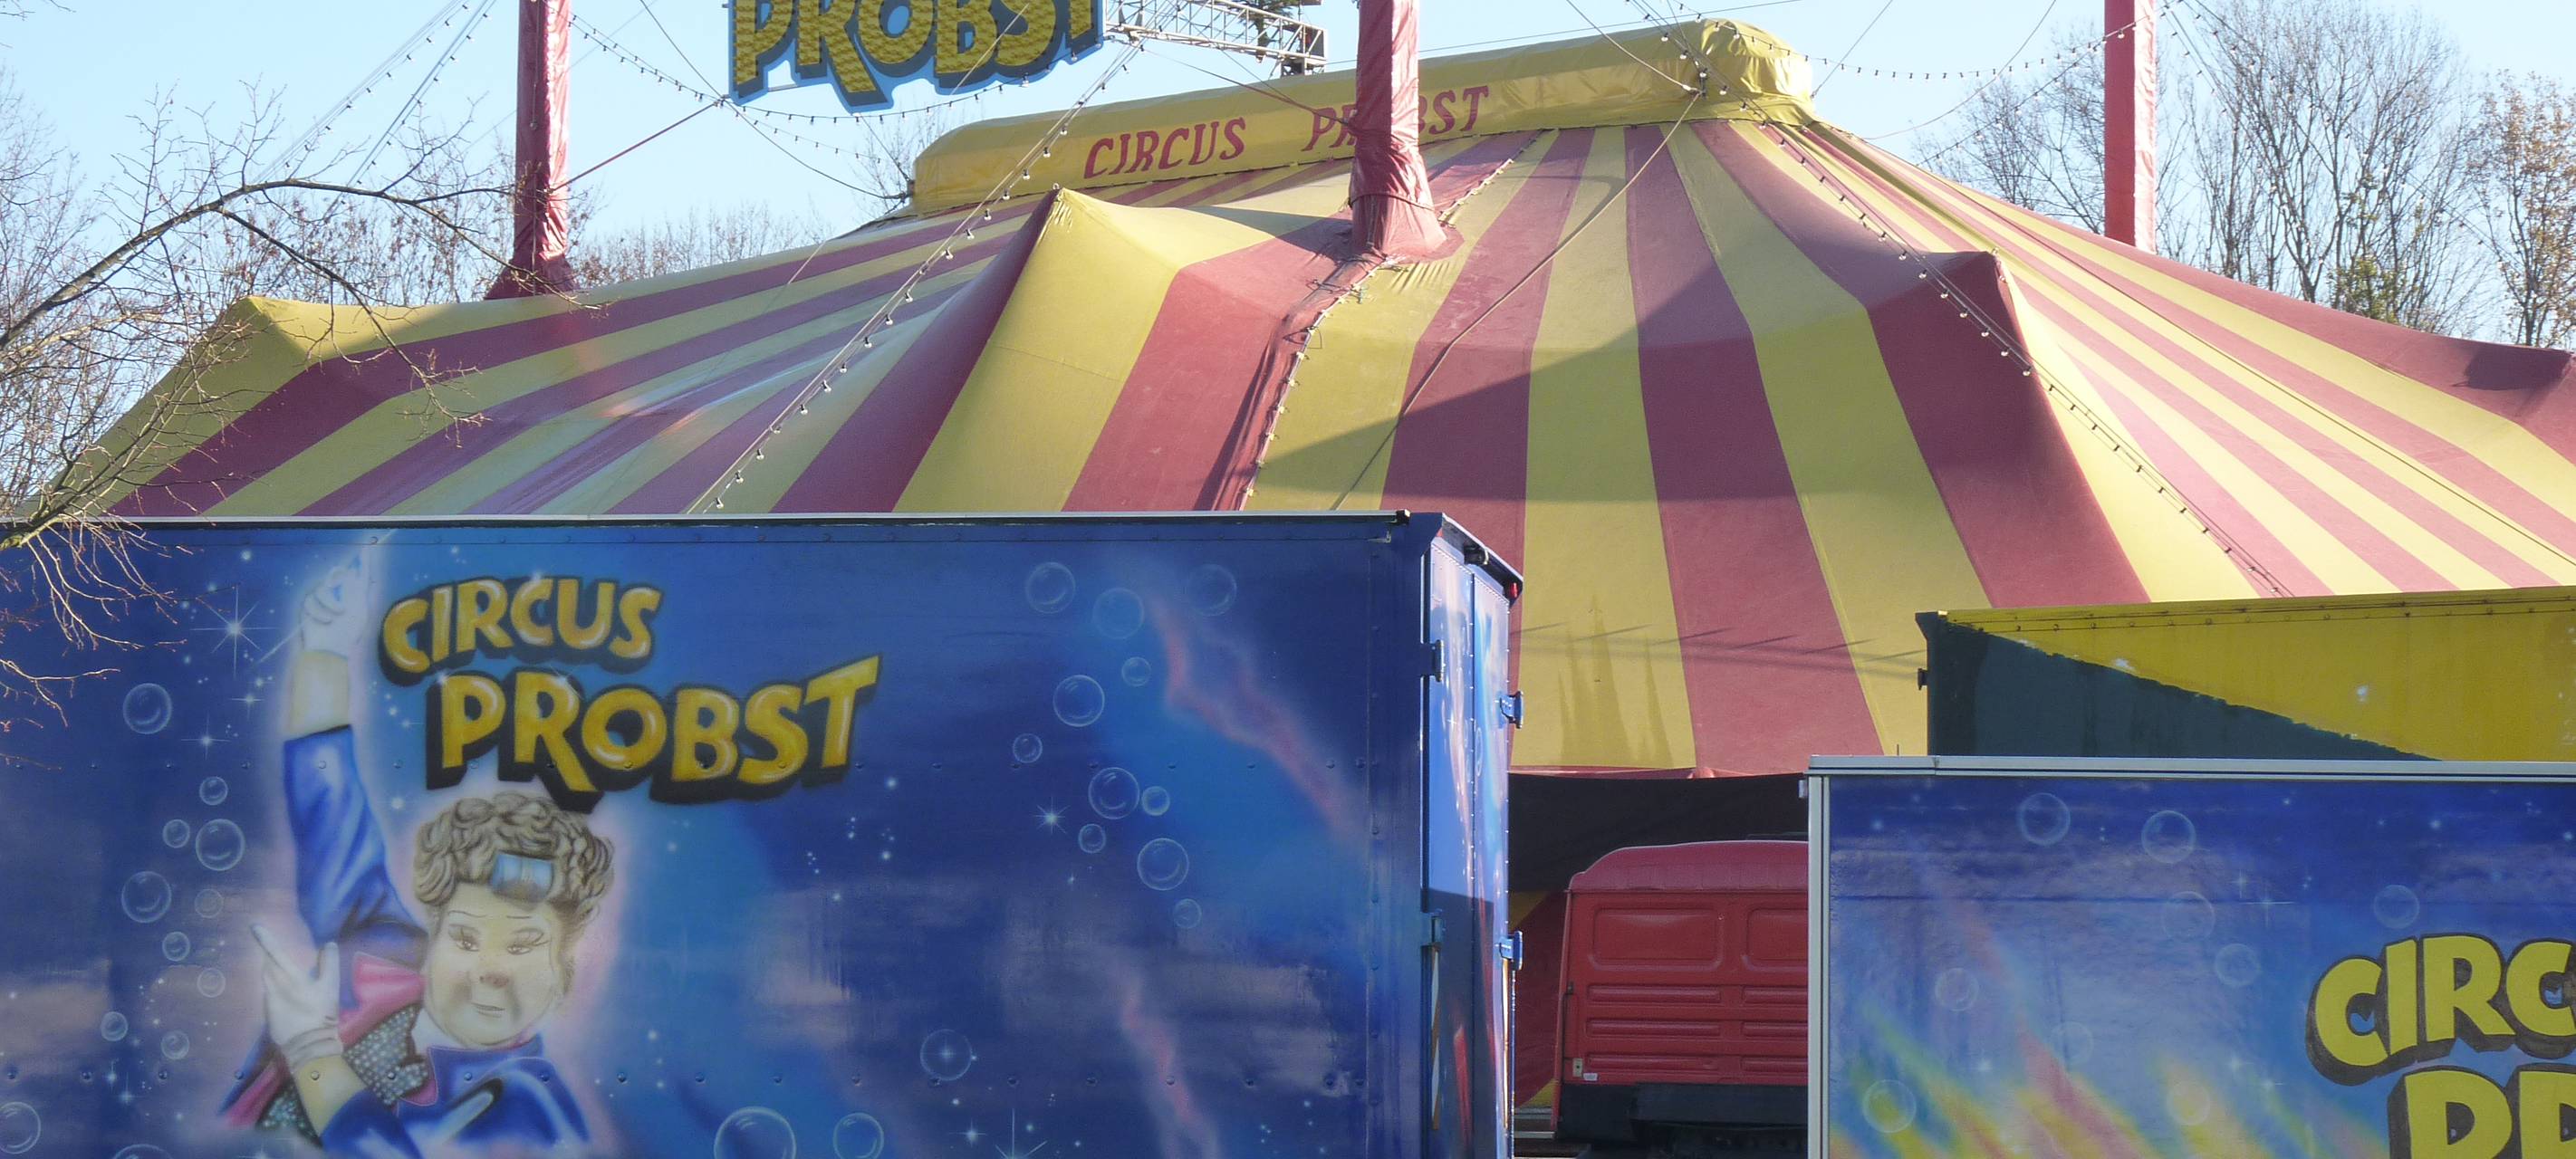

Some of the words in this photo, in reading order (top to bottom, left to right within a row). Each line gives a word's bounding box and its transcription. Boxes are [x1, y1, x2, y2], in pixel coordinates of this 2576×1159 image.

[1083, 116, 1246, 179] CIRCUS
[1301, 85, 1490, 152] PRST
[379, 577, 663, 677] CIRCUS
[430, 656, 880, 803] PROBST
